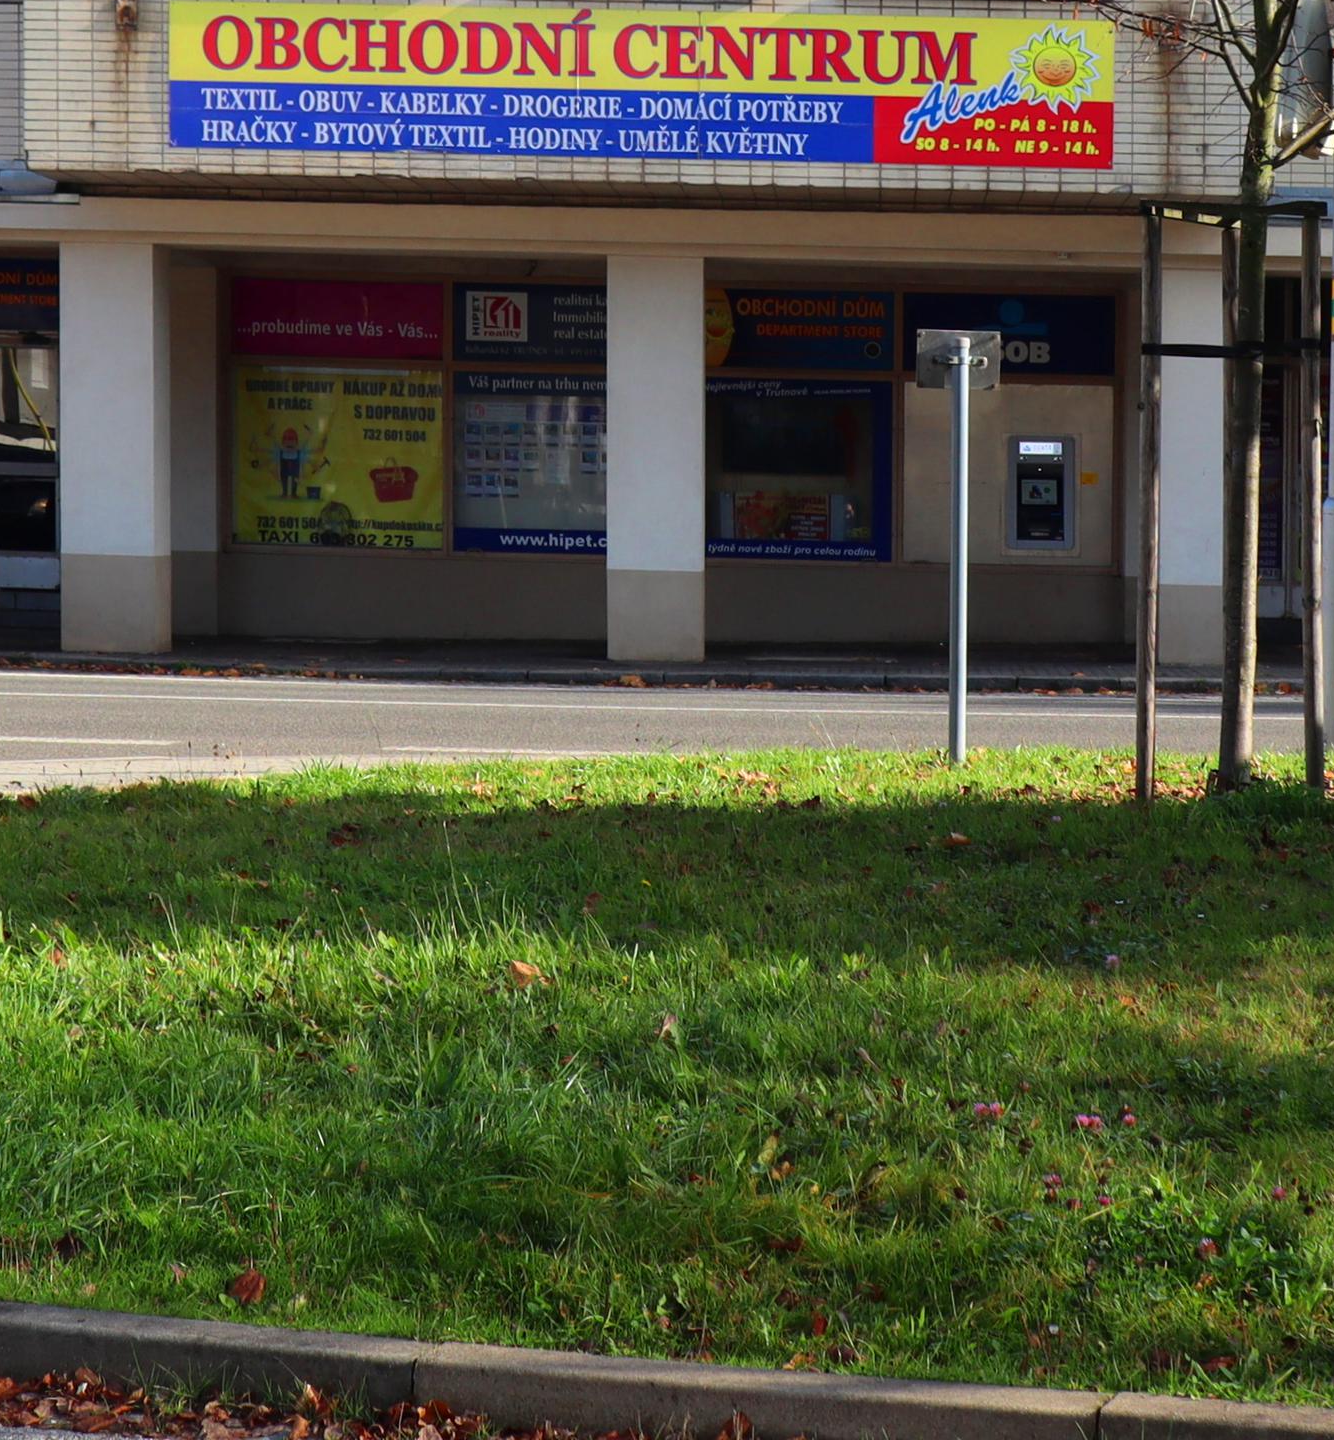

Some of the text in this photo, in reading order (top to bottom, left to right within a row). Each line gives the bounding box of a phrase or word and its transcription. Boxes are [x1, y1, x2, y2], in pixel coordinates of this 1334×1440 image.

[201, 8, 978, 87] OBCHODNÍ CENTRUM
[201, 87, 844, 124] TEXTIL OBUV KABELKY DROGERIE DOMÁCÍ POTŘEBY
[973, 115, 1097, 133] PO PÁ 8 18 h.
[201, 116, 808, 156] HRAČKY BYTOVÝ TEXTIL HODINY UMĚLÉ KVĚTINY
[915, 137, 1000, 152] SO 8 14 h.
[1014, 140, 1100, 155] NE 9 14 h.
[26, 271, 58, 286] DŮM
[553, 293, 592, 307] realitní
[736, 295, 885, 318] OBCHODNÍ DŮM
[472, 296, 480, 336] HIPET
[335, 323, 353, 337] ve
[357, 320, 384, 337] Vás
[484, 328, 521, 338] reality
[553, 326, 575, 340] real
[756, 323, 884, 339] DEPARTMENT STORE
[1002, 340, 1051, 364] OB
[343, 378, 387, 396] NÁKUP
[390, 378, 404, 397] AŽ
[469, 375, 489, 388] Váš
[492, 377, 535, 392] partner
[538, 379, 552, 390] na
[555, 377, 580, 390] trhu
[757, 380, 782, 391] ceny
[766, 386, 808, 398] Trutnově
[354, 404, 435, 422] S DOPRAVOU
[362, 428, 427, 442] 732 601 504
[256, 515, 276, 529] 732
[258, 529, 299, 543] TAXI
[383, 535, 415, 547] 275
[708, 542, 876, 557] týdně nové zboží pro celou rodinu
